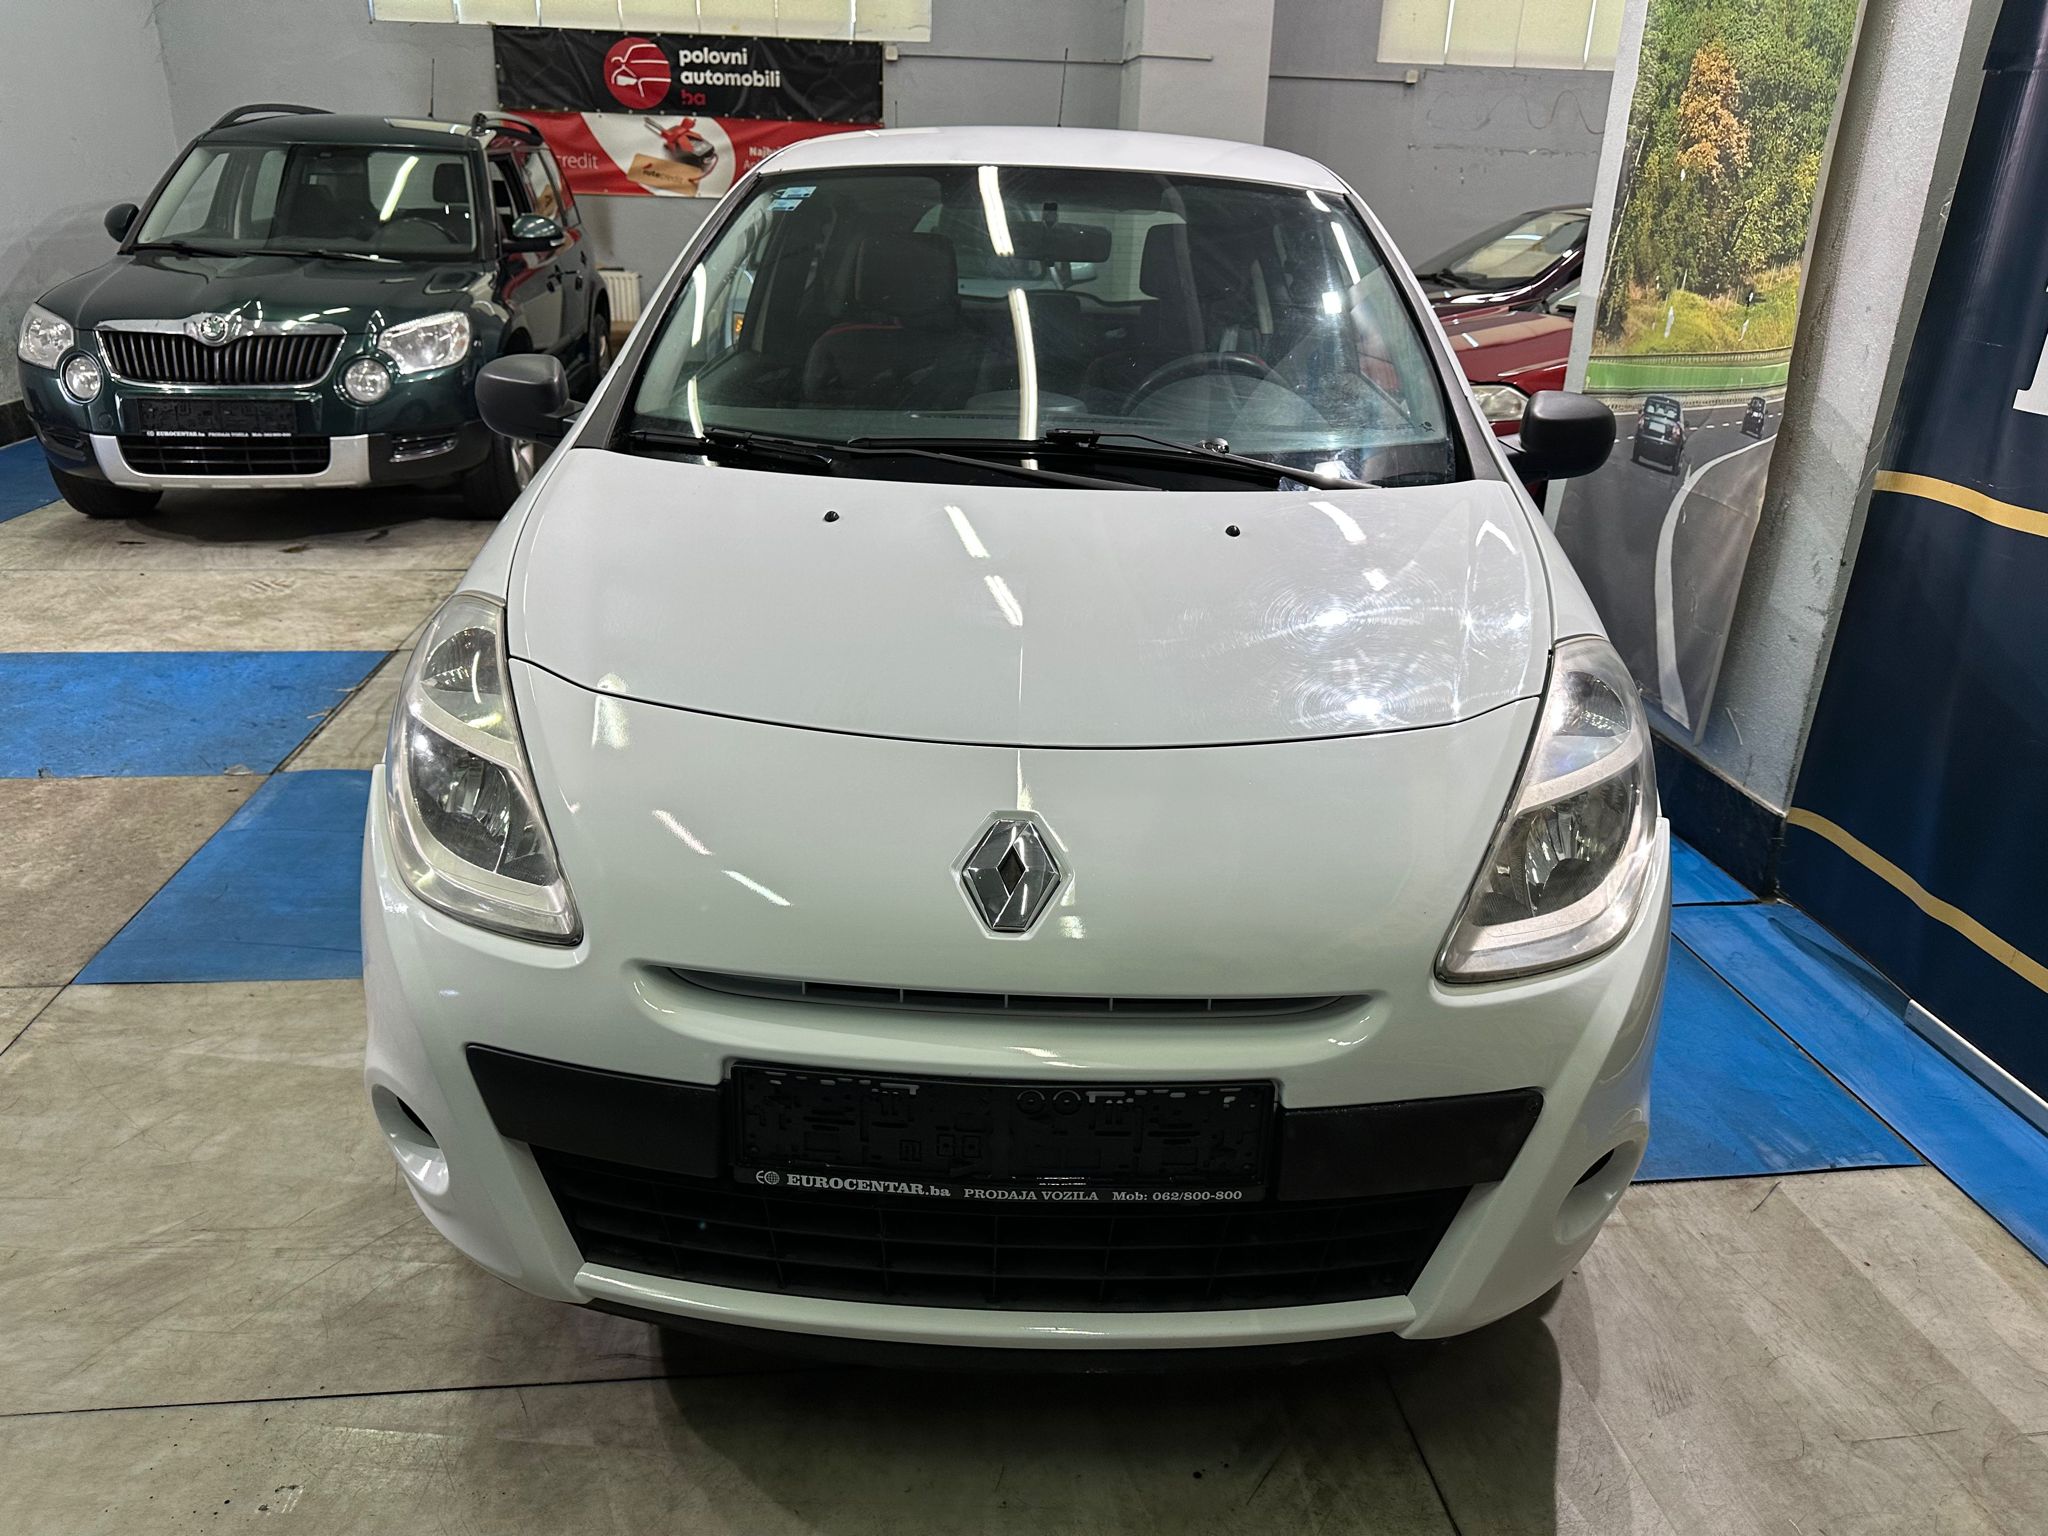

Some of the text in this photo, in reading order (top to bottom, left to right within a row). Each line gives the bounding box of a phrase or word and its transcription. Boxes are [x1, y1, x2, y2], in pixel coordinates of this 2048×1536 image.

[678, 47, 748, 67] polovni
[680, 69, 781, 88] automobili
[786, 1173, 1243, 1202] EUROCENTAR.ba PRODAJA VOZILA Mob: 062/800-800
